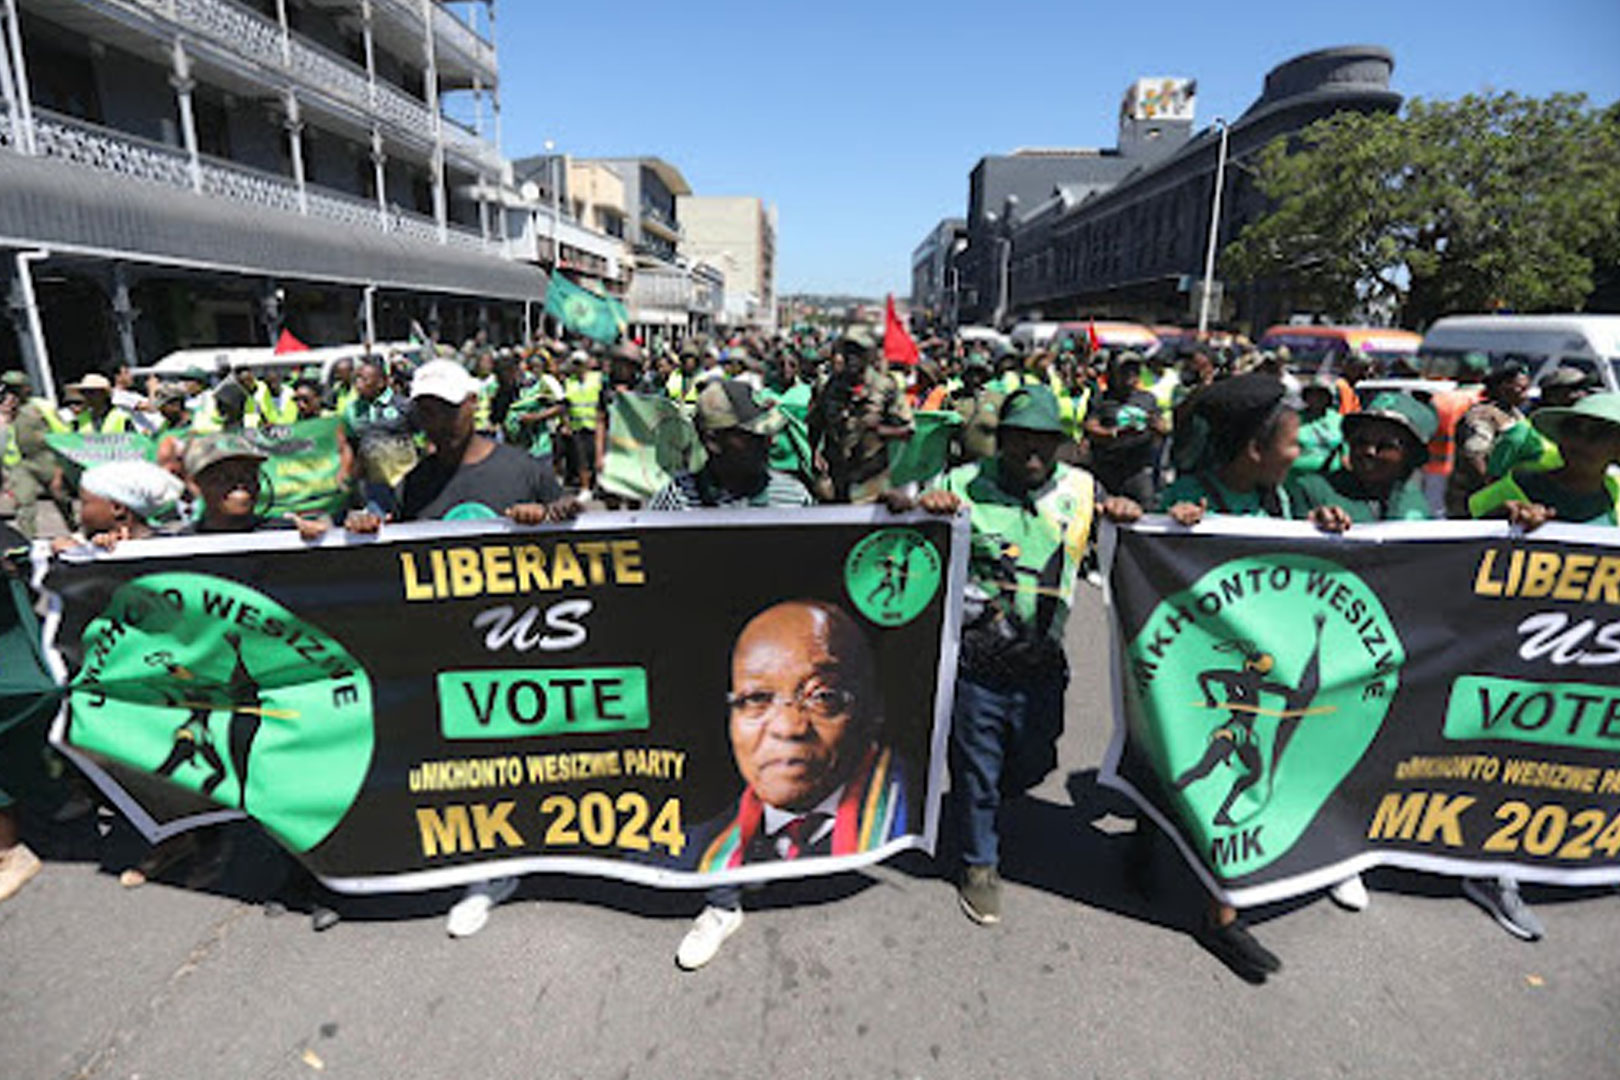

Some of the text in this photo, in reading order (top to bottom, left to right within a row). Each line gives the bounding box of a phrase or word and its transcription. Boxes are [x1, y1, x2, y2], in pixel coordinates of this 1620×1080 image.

[400, 540, 646, 600] LIBERATE
[462, 679, 627, 725] VOTE
[525, 751, 621, 784] WESIZWE
[622, 749, 685, 779] PARTY
[416, 791, 686, 857] MK 2024
[1210, 824, 1265, 866] MK
[1369, 791, 1620, 860] MK 2024
